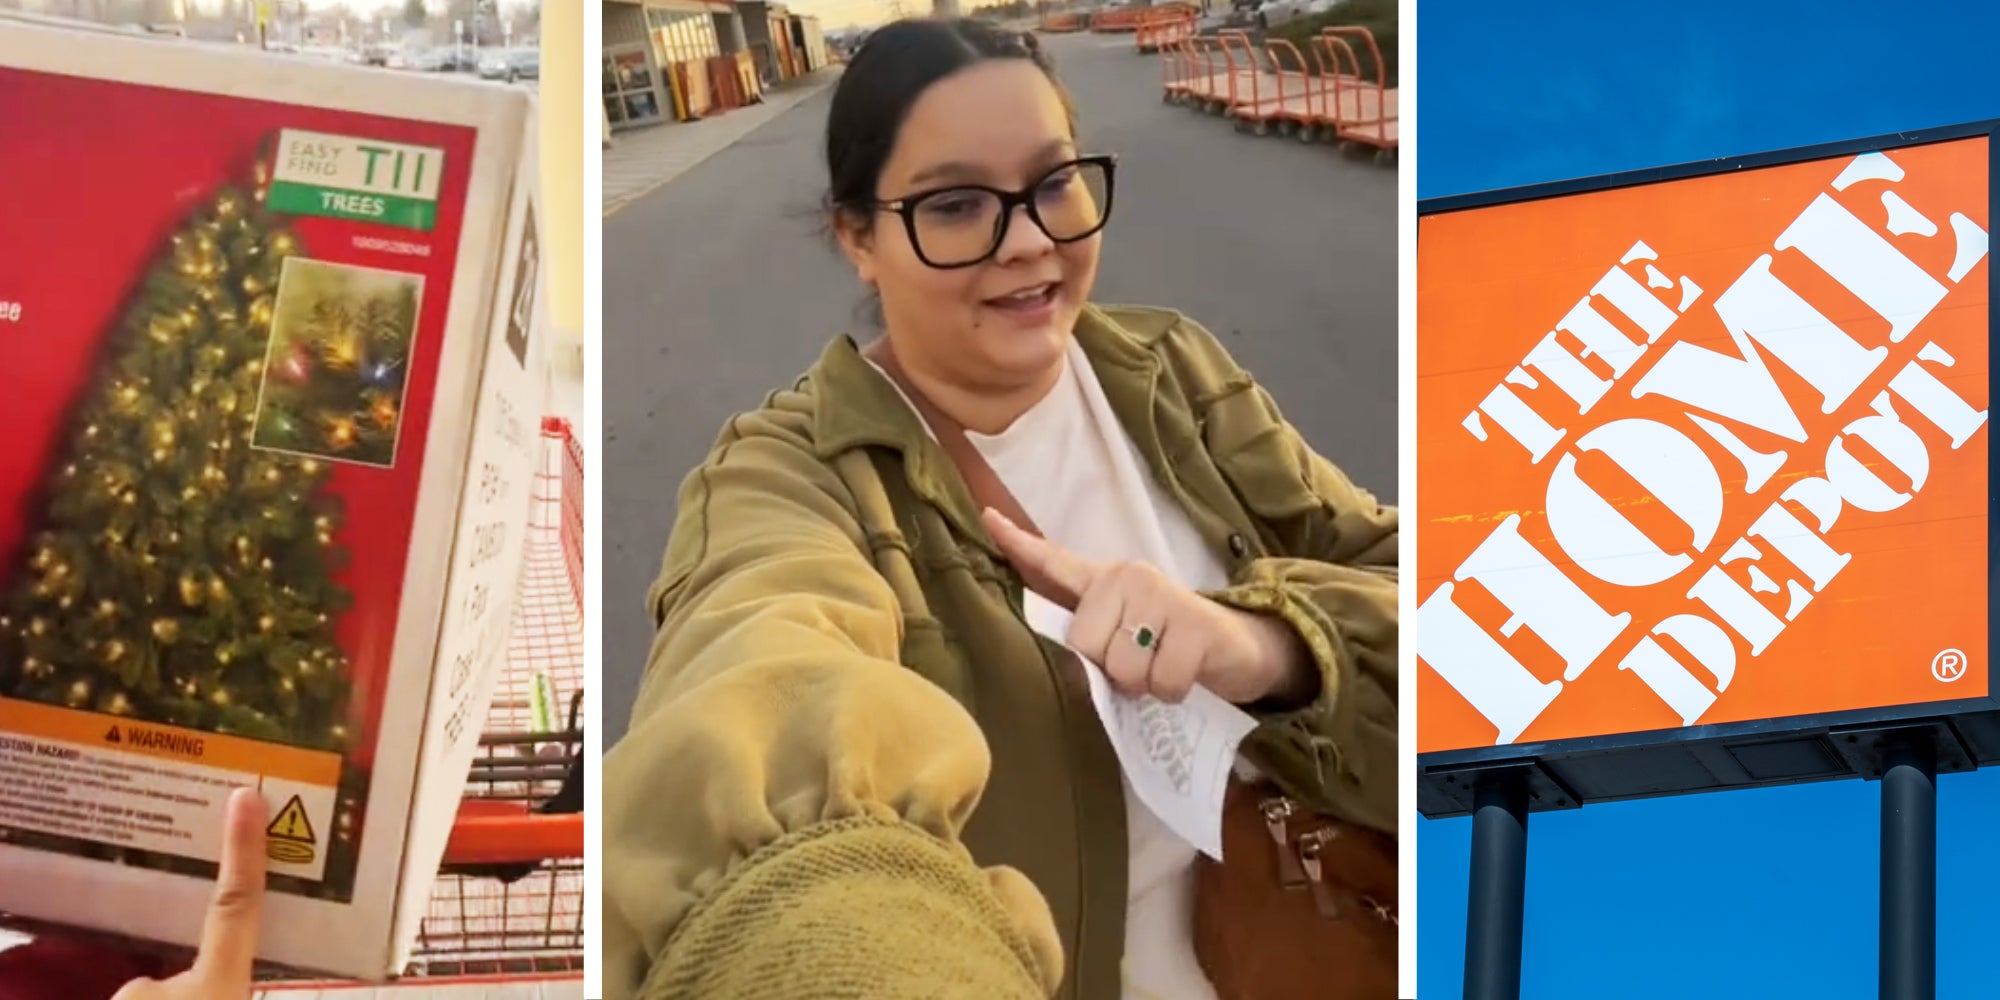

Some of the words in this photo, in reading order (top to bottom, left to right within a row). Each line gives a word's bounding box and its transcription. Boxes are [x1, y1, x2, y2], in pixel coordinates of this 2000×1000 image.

[289, 140, 342, 159] EASY
[287, 157, 338, 175] FIND
[320, 191, 385, 216] TREES
[1461, 240, 1703, 464] THE
[1417, 152, 1988, 745] HOME
[1618, 340, 1988, 727] DEPOT
[127, 727, 205, 756] WARNING
